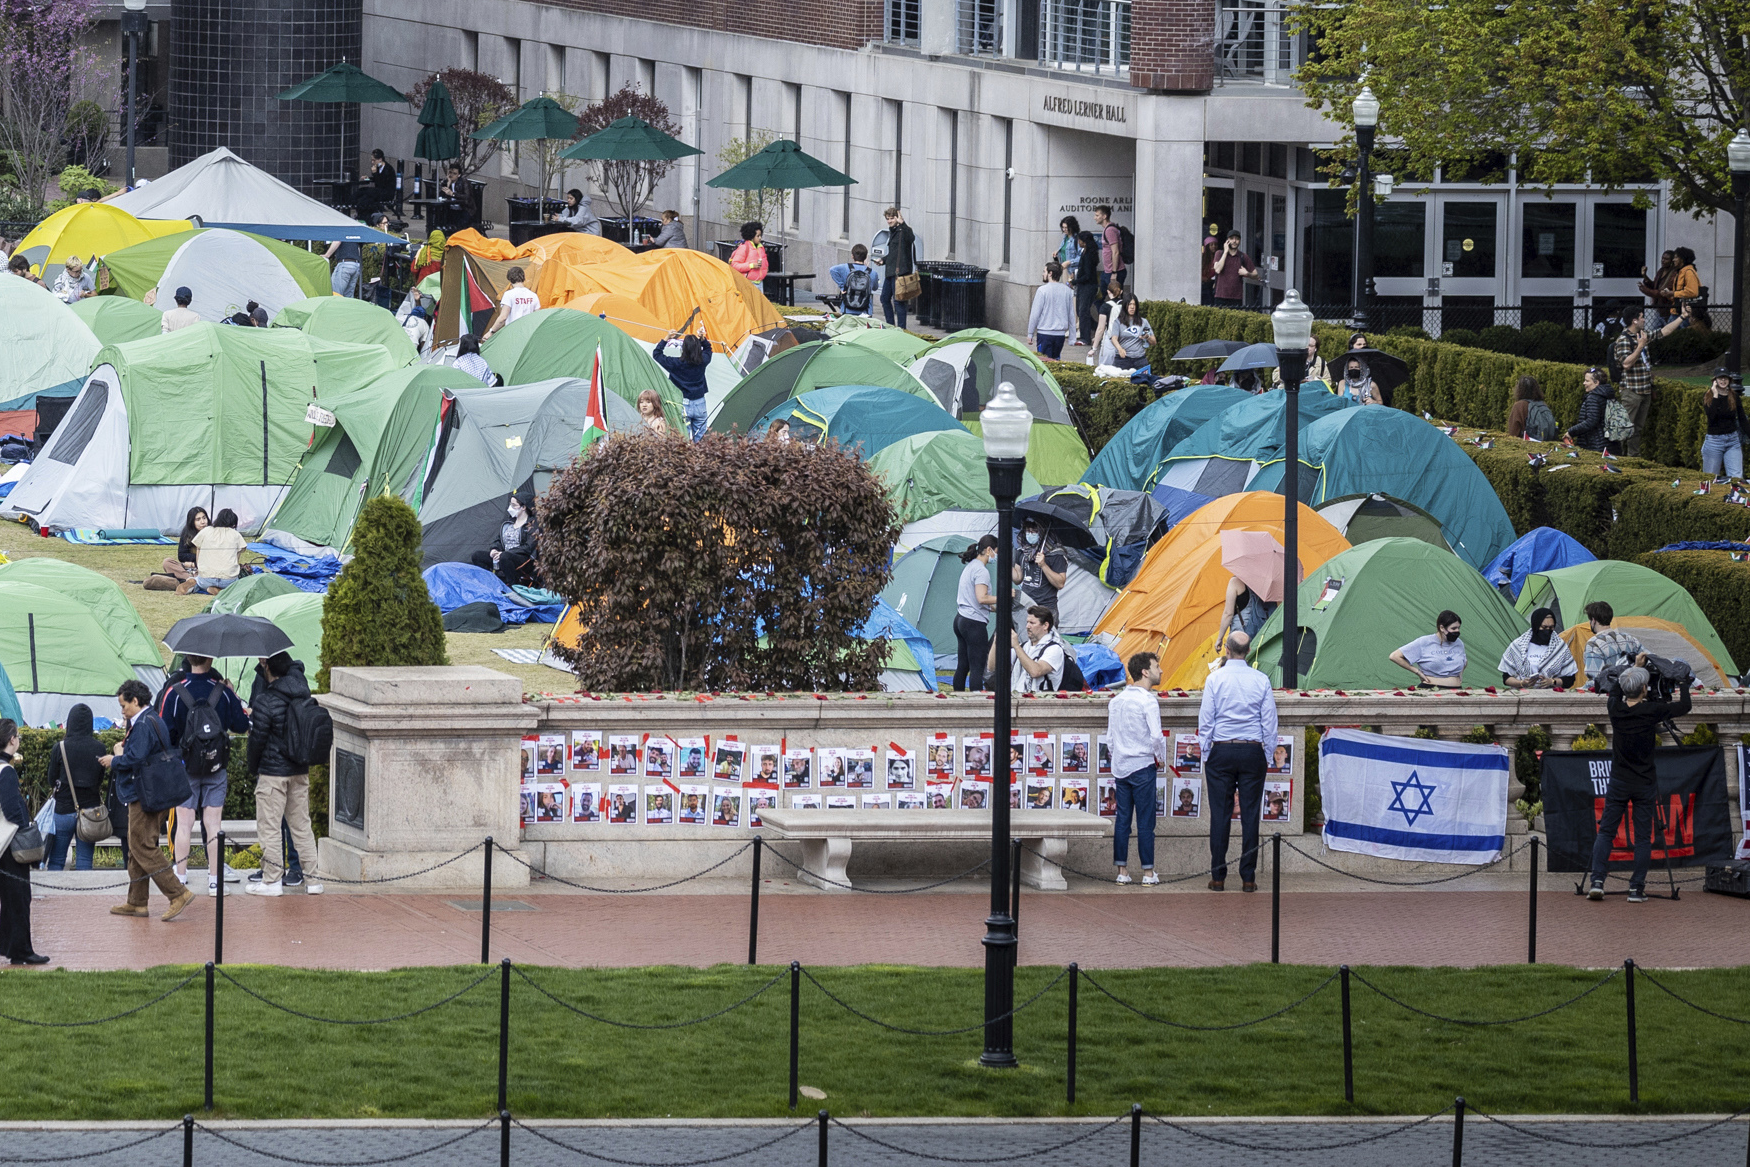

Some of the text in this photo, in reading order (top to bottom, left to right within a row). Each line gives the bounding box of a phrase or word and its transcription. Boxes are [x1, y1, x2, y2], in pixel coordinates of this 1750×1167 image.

[1043, 95, 1127, 123] ALFRED LERNER HALL
[1080, 196, 1110, 204] ROONE
[515, 297, 534, 305] STAFF
